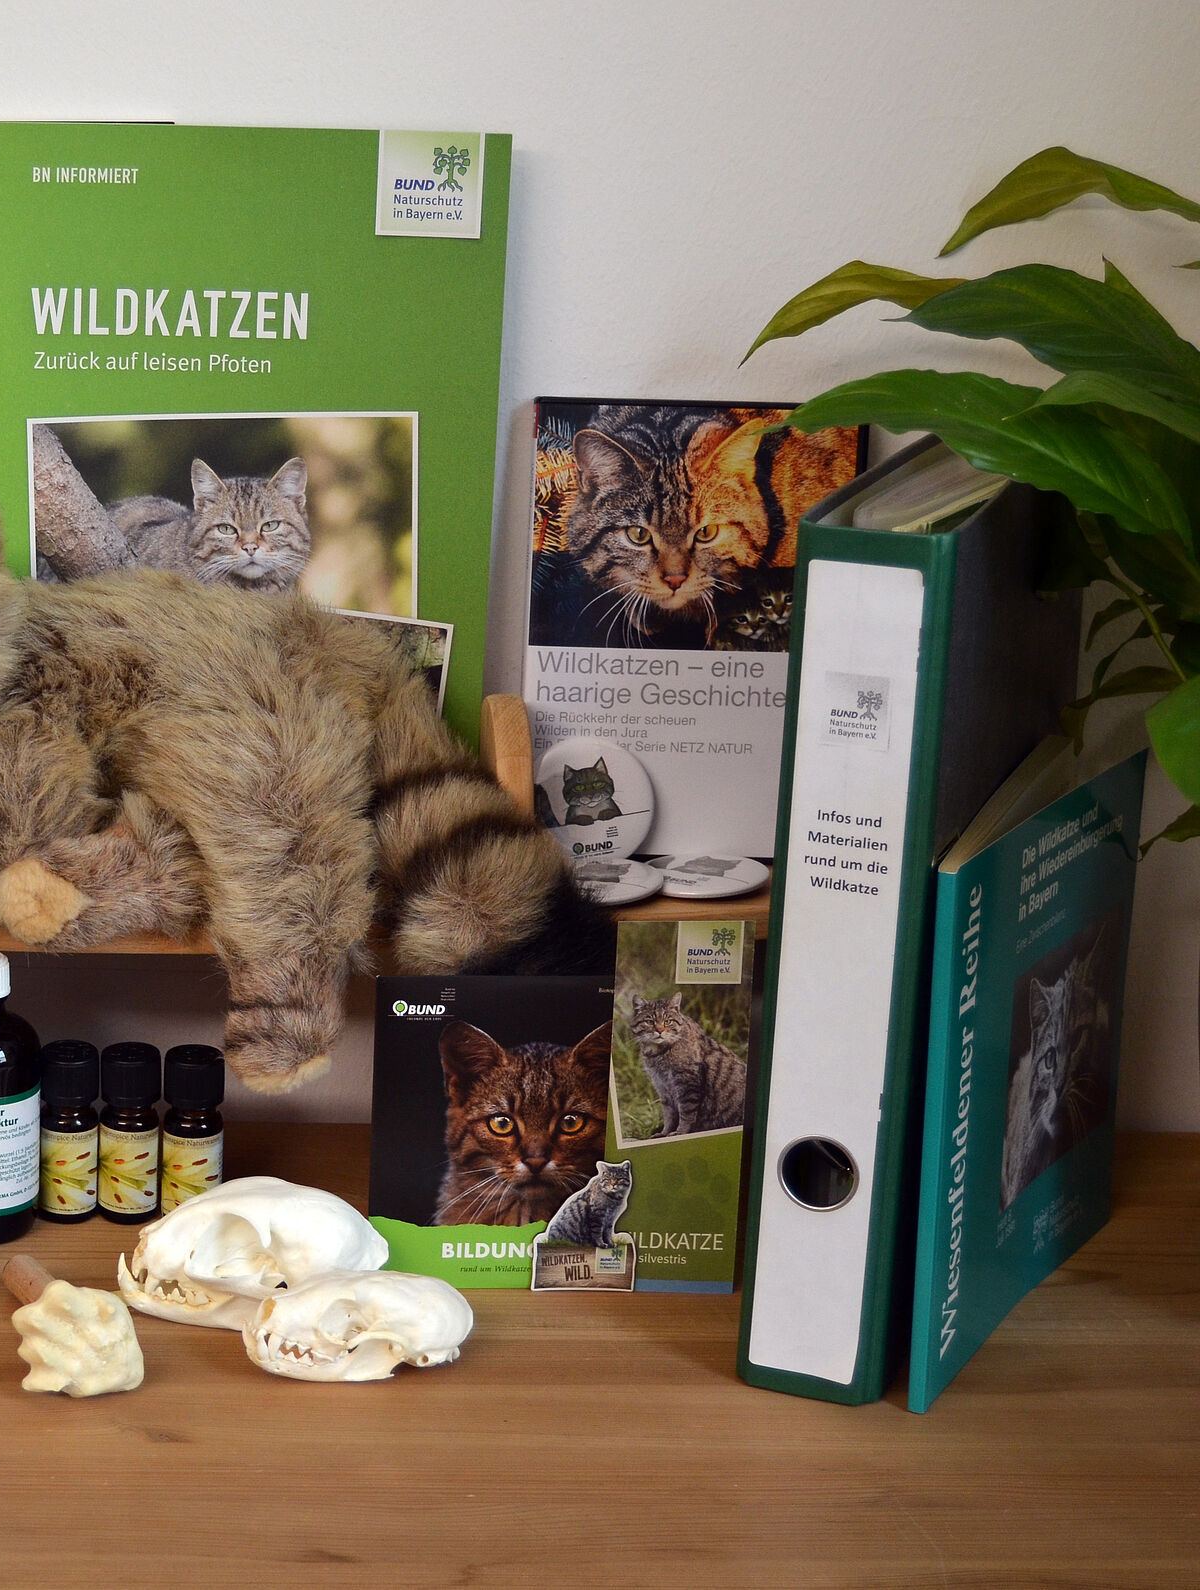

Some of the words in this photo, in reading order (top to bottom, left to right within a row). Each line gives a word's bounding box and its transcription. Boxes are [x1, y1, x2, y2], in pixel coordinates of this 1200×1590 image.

[32, 167, 51, 183] BN
[55, 167, 139, 185] INFORMIERT
[394, 179, 435, 191] BUND
[393, 194, 463, 207] Naturschutz
[393, 208, 403, 219] in
[406, 208, 443, 222] Bayern
[446, 210, 463, 221] e.V.
[31, 287, 310, 341] WILDKATZEN
[33, 351, 101, 371] Zurück
[105, 352, 139, 371] auf
[144, 352, 201, 373] leisen
[208, 353, 272, 375] Pfoten
[537, 651, 679, 676] Wildkatzen
[711, 656, 764, 679] eine
[536, 680, 632, 709] haarige
[640, 682, 787, 708] Geschichte
[535, 711, 554, 723] Die
[559, 711, 618, 725] Rückkehr
[620, 713, 641, 725] der
[645, 714, 696, 726] scheuen
[830, 708, 858, 719] BUND
[535, 724, 576, 737] Wilden
[580, 725, 591, 737] in
[594, 726, 618, 738] den
[621, 727, 648, 738] Jura
[829, 718, 877, 731] Naturschutz
[829, 728, 837, 736] in
[838, 728, 864, 740] Bayern
[864, 732, 877, 740] e.V.
[629, 741, 666, 752] Serie
[670, 742, 705, 753] NETZ
[708, 743, 753, 755] NATUR
[817, 809, 851, 825] Infos
[855, 816, 882, 828] und
[807, 830, 888, 852] Materialien
[1021, 845, 1036, 869] Die
[1038, 817, 1080, 857] Wildkatze
[1082, 800, 1099, 828] und
[585, 840, 613, 854] BUND
[804, 854, 836, 868] rund
[841, 860, 862, 871] um
[867, 861, 888, 875] die
[809, 875, 879, 896] Wildkatze
[1019, 871, 1037, 896] ihre
[1018, 903, 1027, 923] in
[1028, 880, 1059, 916] Bayern
[687, 948, 714, 956] BUND
[694, 966, 719, 975] Bayern
[408, 1004, 446, 1015] BUND
[939, 1026, 974, 1361] Wiesenfeldener
[958, 883, 983, 1021] Reihe
[630, 1231, 724, 1251] ILDKATZE
[541, 1253, 588, 1267] WILDKATZEN.
[637, 1253, 687, 1265] silvestris
[460, 1265, 478, 1273] rund
[564, 1264, 594, 1282] WILD.
